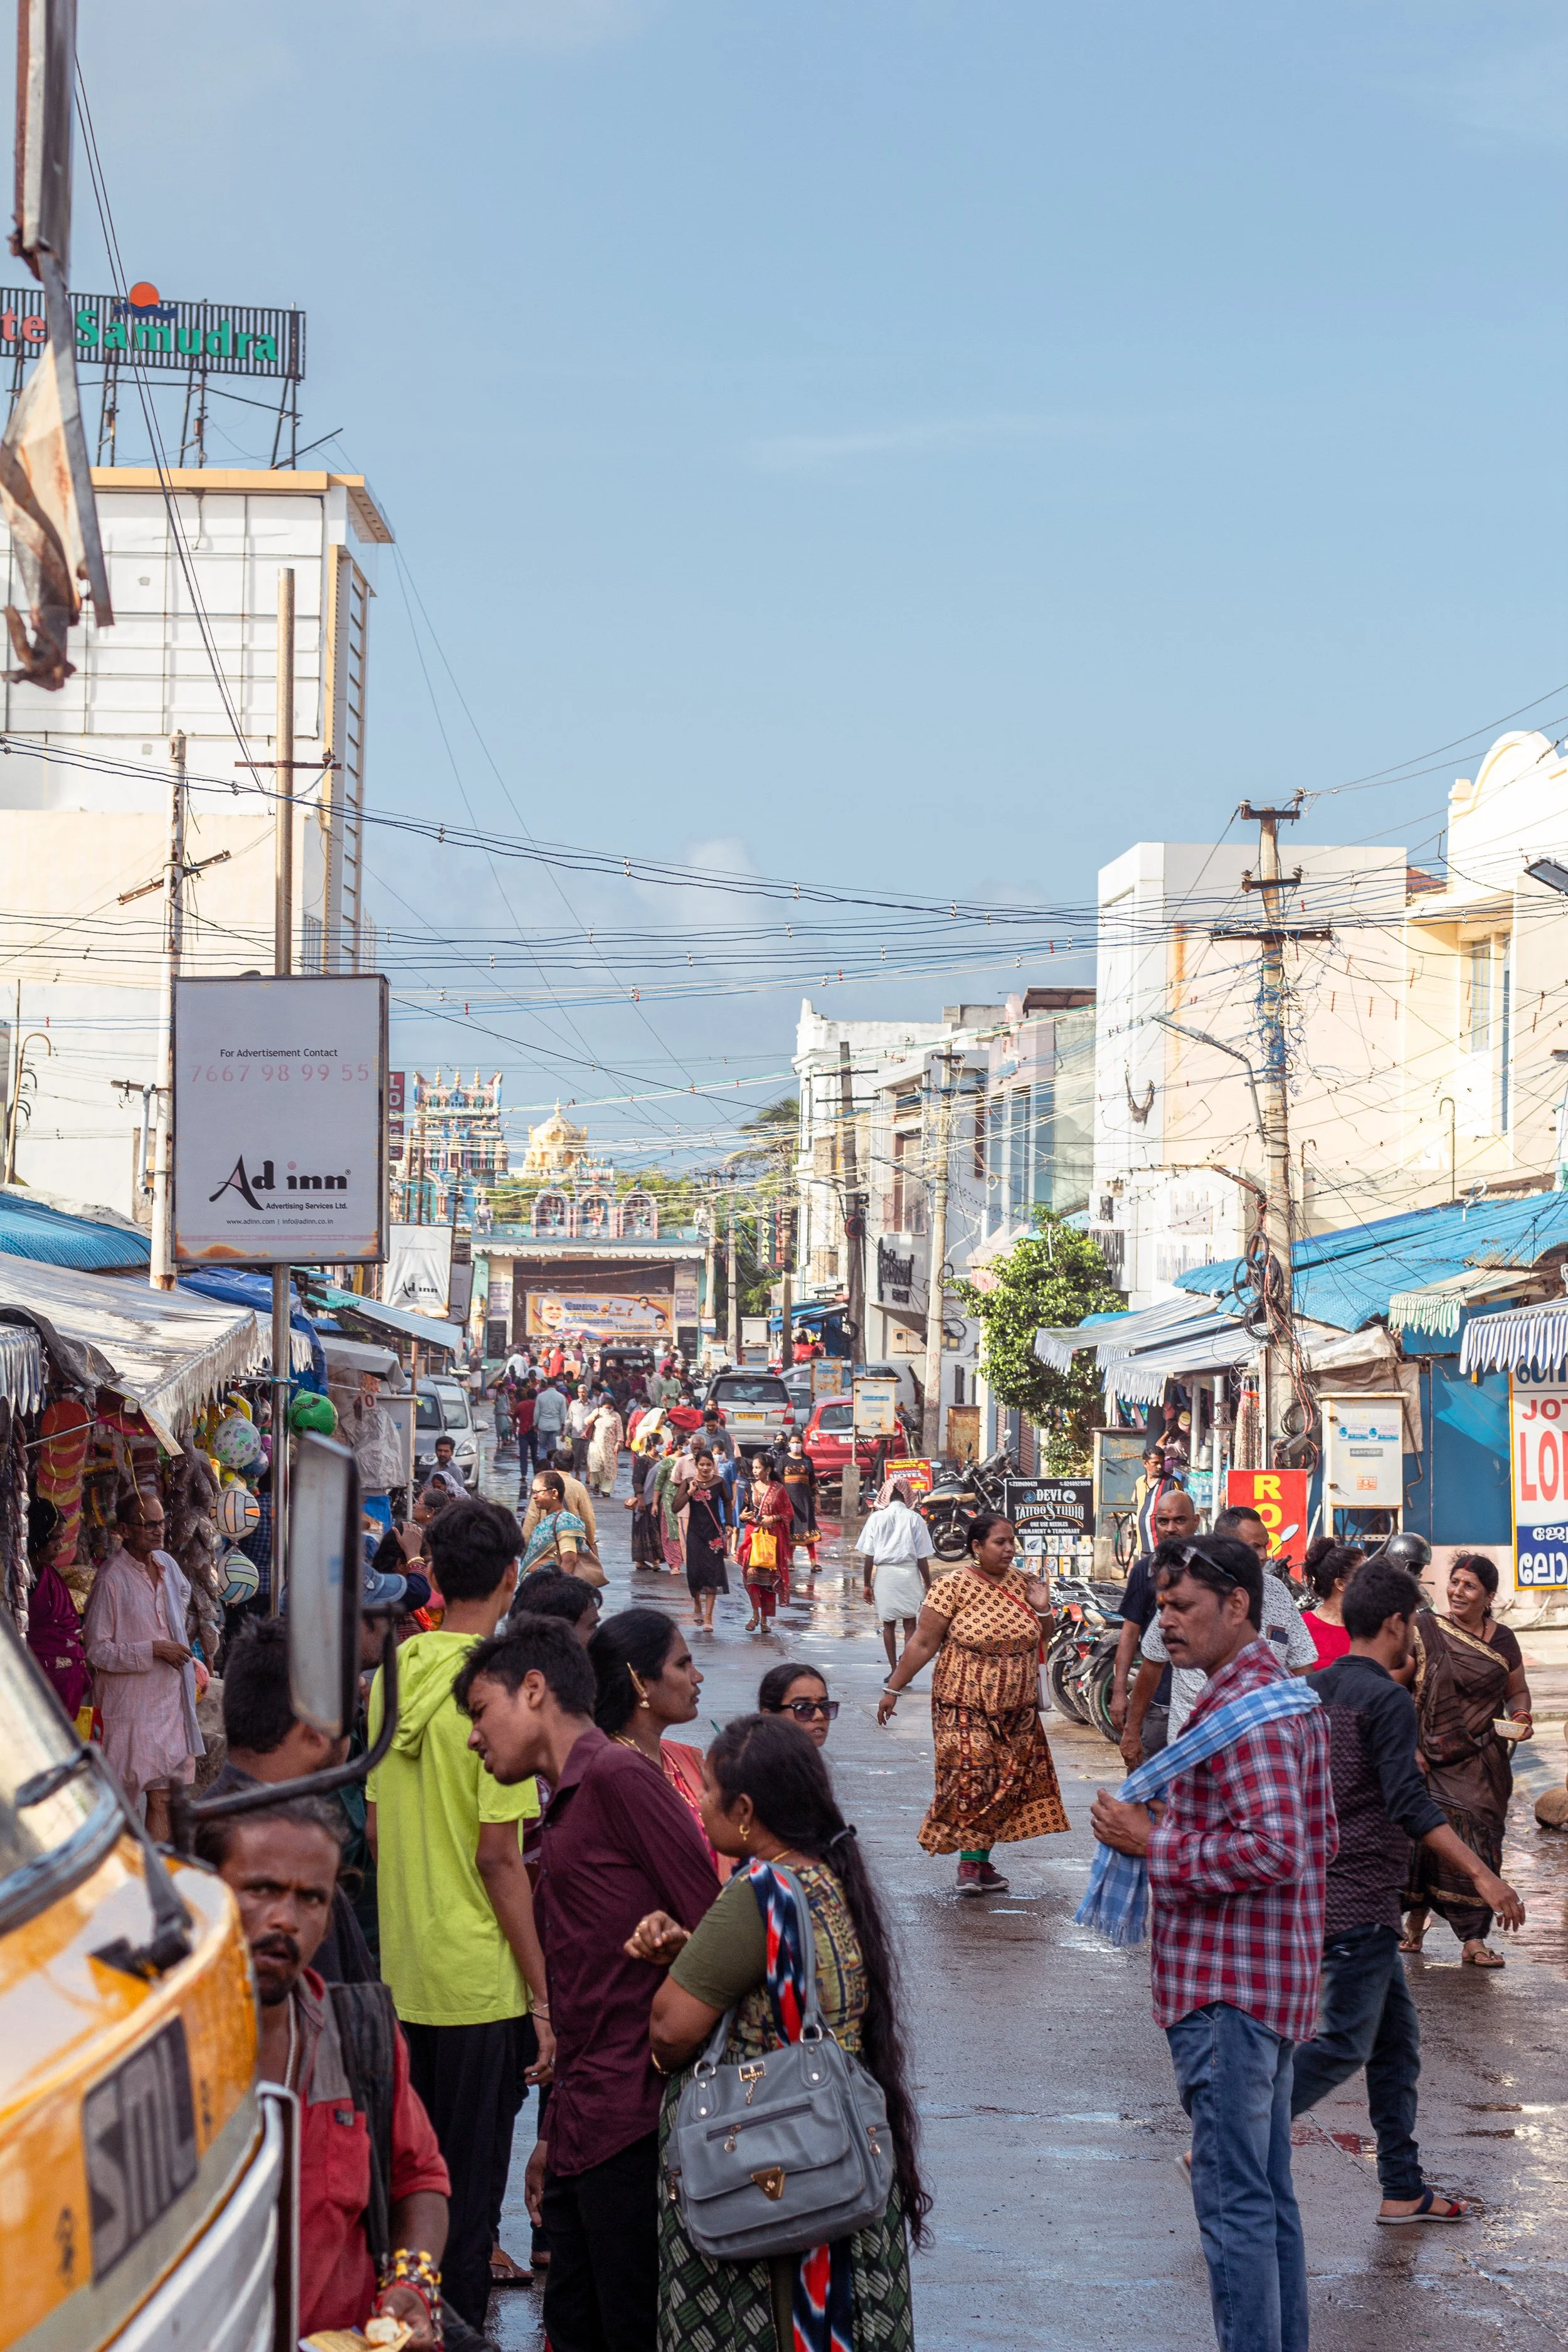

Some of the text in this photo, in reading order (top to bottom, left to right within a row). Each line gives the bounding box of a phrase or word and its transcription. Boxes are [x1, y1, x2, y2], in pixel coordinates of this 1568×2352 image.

[77, 309, 278, 361] Samudra
[220, 1048, 339, 1057] For Advertisement Contact
[190, 1063, 369, 1083] 7667 98 99 55
[209, 1154, 276, 1211] Ad
[266, 1202, 304, 1210] Advertising
[1520, 1430, 1568, 1502] LO
[1036, 1489, 1062, 1501] DEVI
[1014, 1506, 1047, 1520] TATTOO
